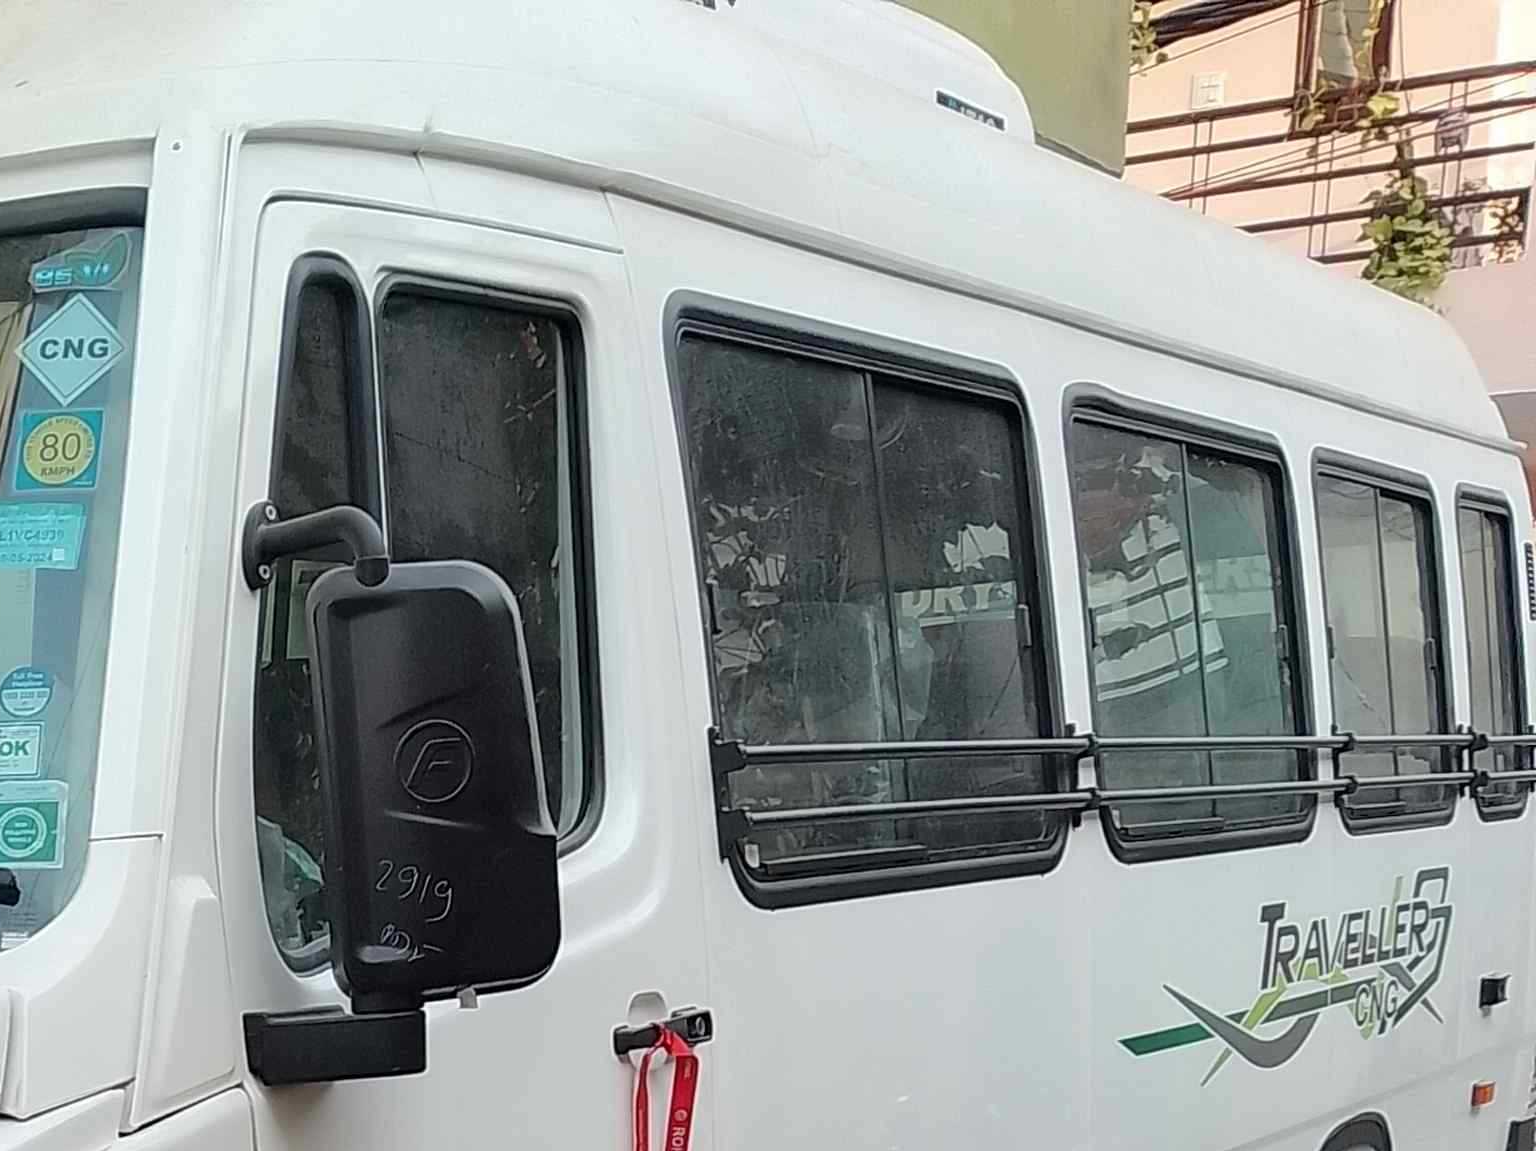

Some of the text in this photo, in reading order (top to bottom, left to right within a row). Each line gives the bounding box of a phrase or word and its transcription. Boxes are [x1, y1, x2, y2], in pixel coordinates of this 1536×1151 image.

[39, 338, 109, 360] CNG
[39, 432, 81, 462] 80
[40, 466, 75, 476] KMPH
[0, 740, 30, 757] OK
[1259, 900, 1430, 990] TRAVELLER
[1355, 979, 1399, 1032] CNG
